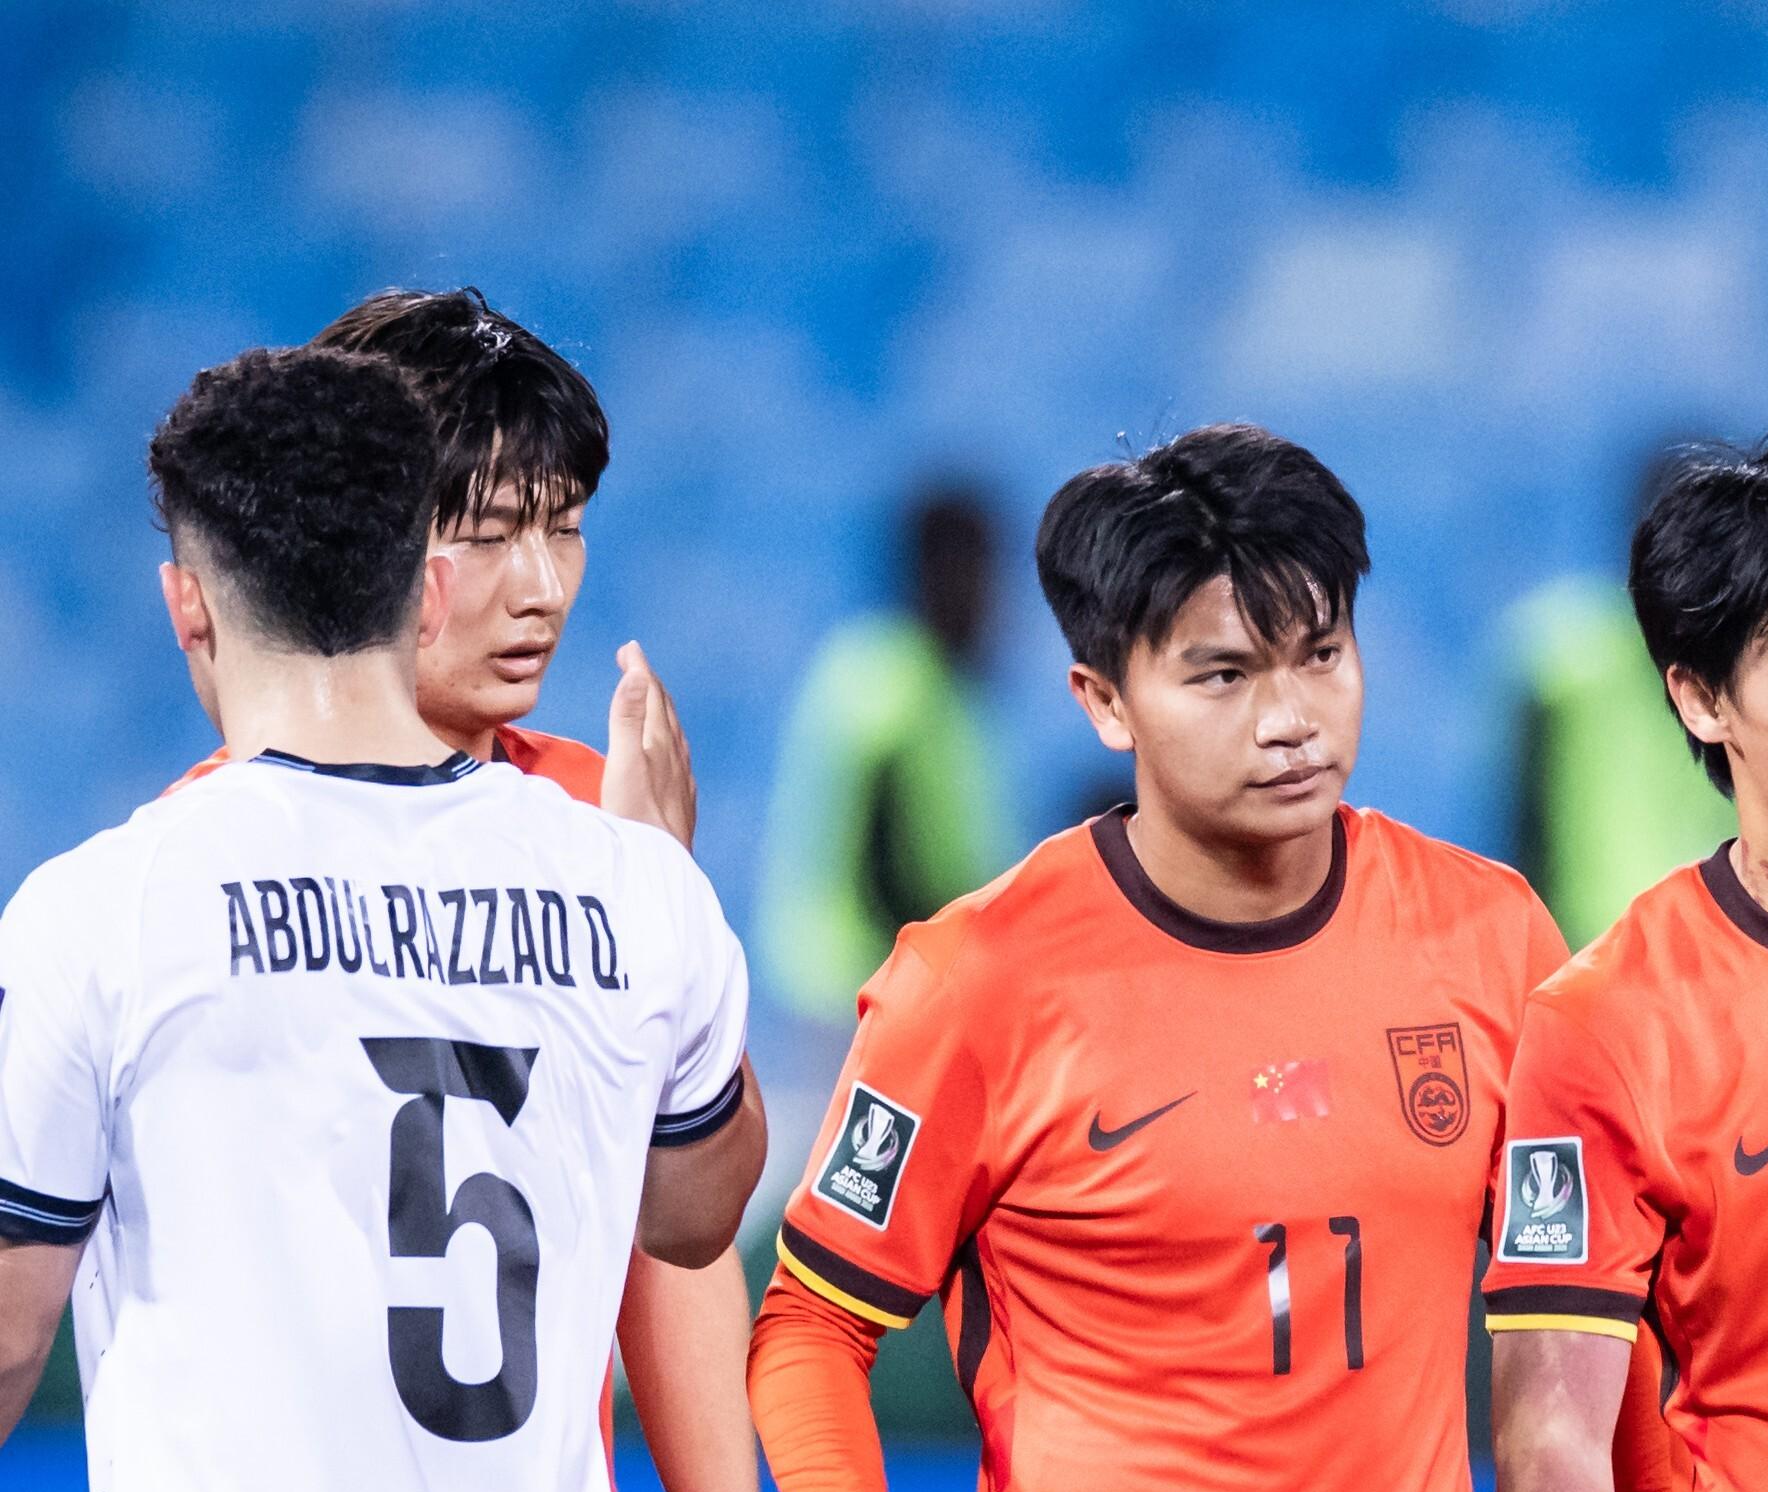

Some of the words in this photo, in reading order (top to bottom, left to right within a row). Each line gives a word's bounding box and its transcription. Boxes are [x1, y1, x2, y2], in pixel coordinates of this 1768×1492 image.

[221, 877, 572, 986] ABDULRAZZAQ
[577, 895, 630, 991] Q.
[1396, 1032, 1456, 1055] CFA
[359, 1037, 541, 1442] 5
[1253, 1216, 1364, 1375] 11
